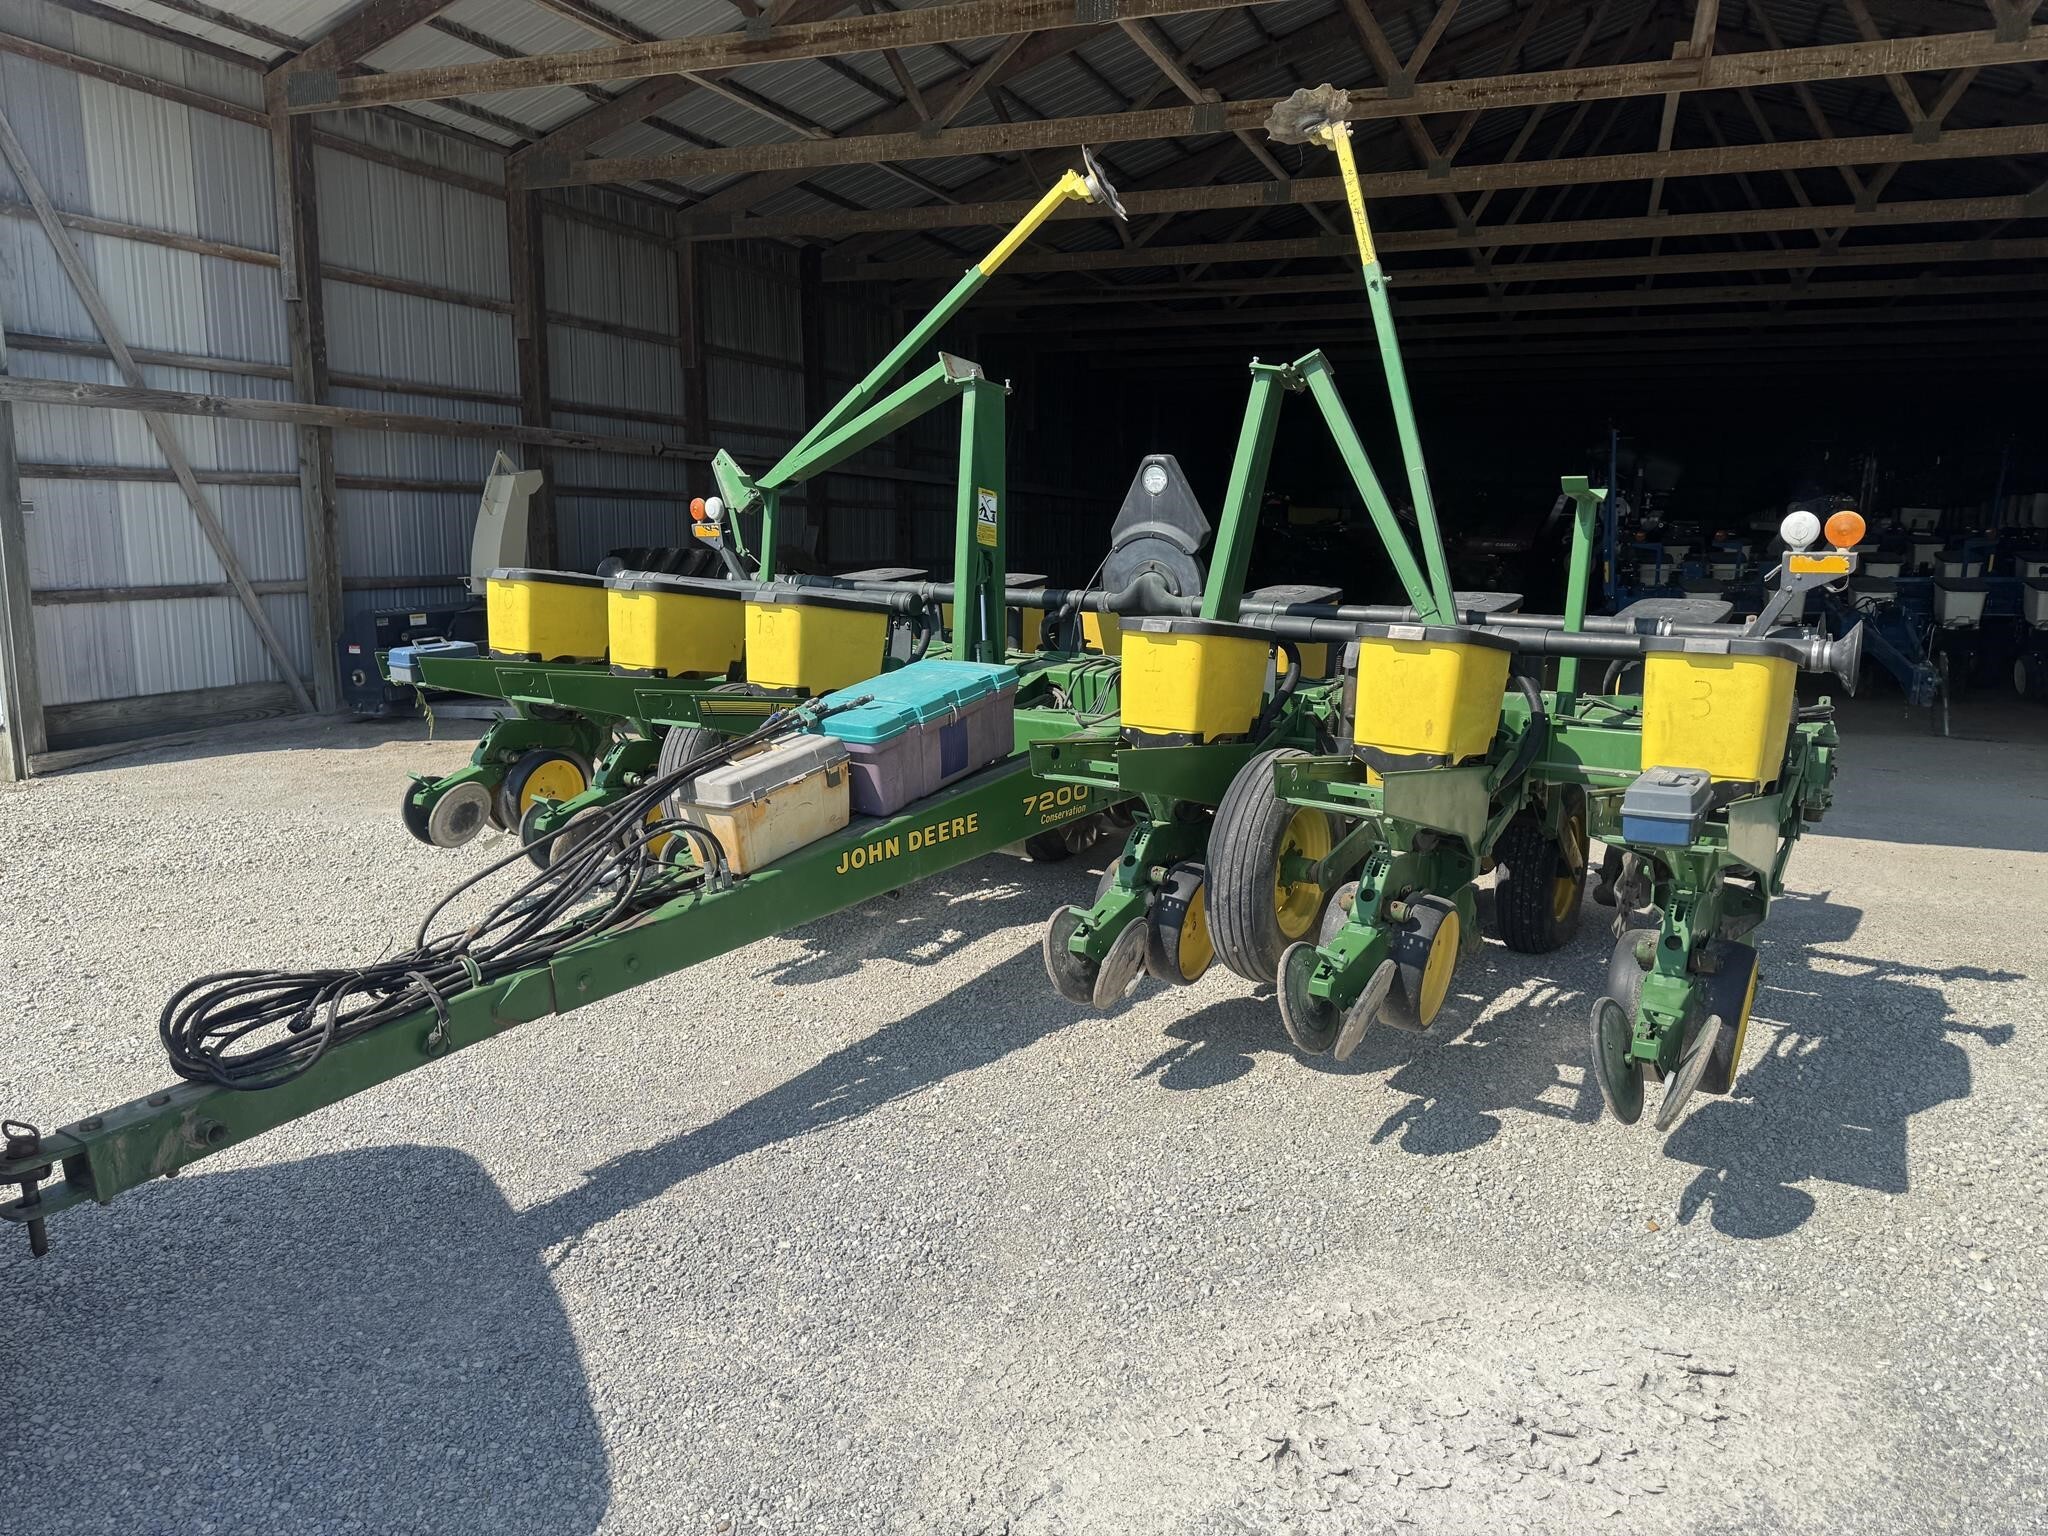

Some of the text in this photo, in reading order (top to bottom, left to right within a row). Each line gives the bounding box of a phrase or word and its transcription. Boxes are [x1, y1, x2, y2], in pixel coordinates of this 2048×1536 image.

[1690, 680, 1713, 720] 3
[1023, 784, 1088, 816] 7200
[1040, 804, 1087, 825] Conservation
[836, 812, 979, 875] JOHN DEERE
